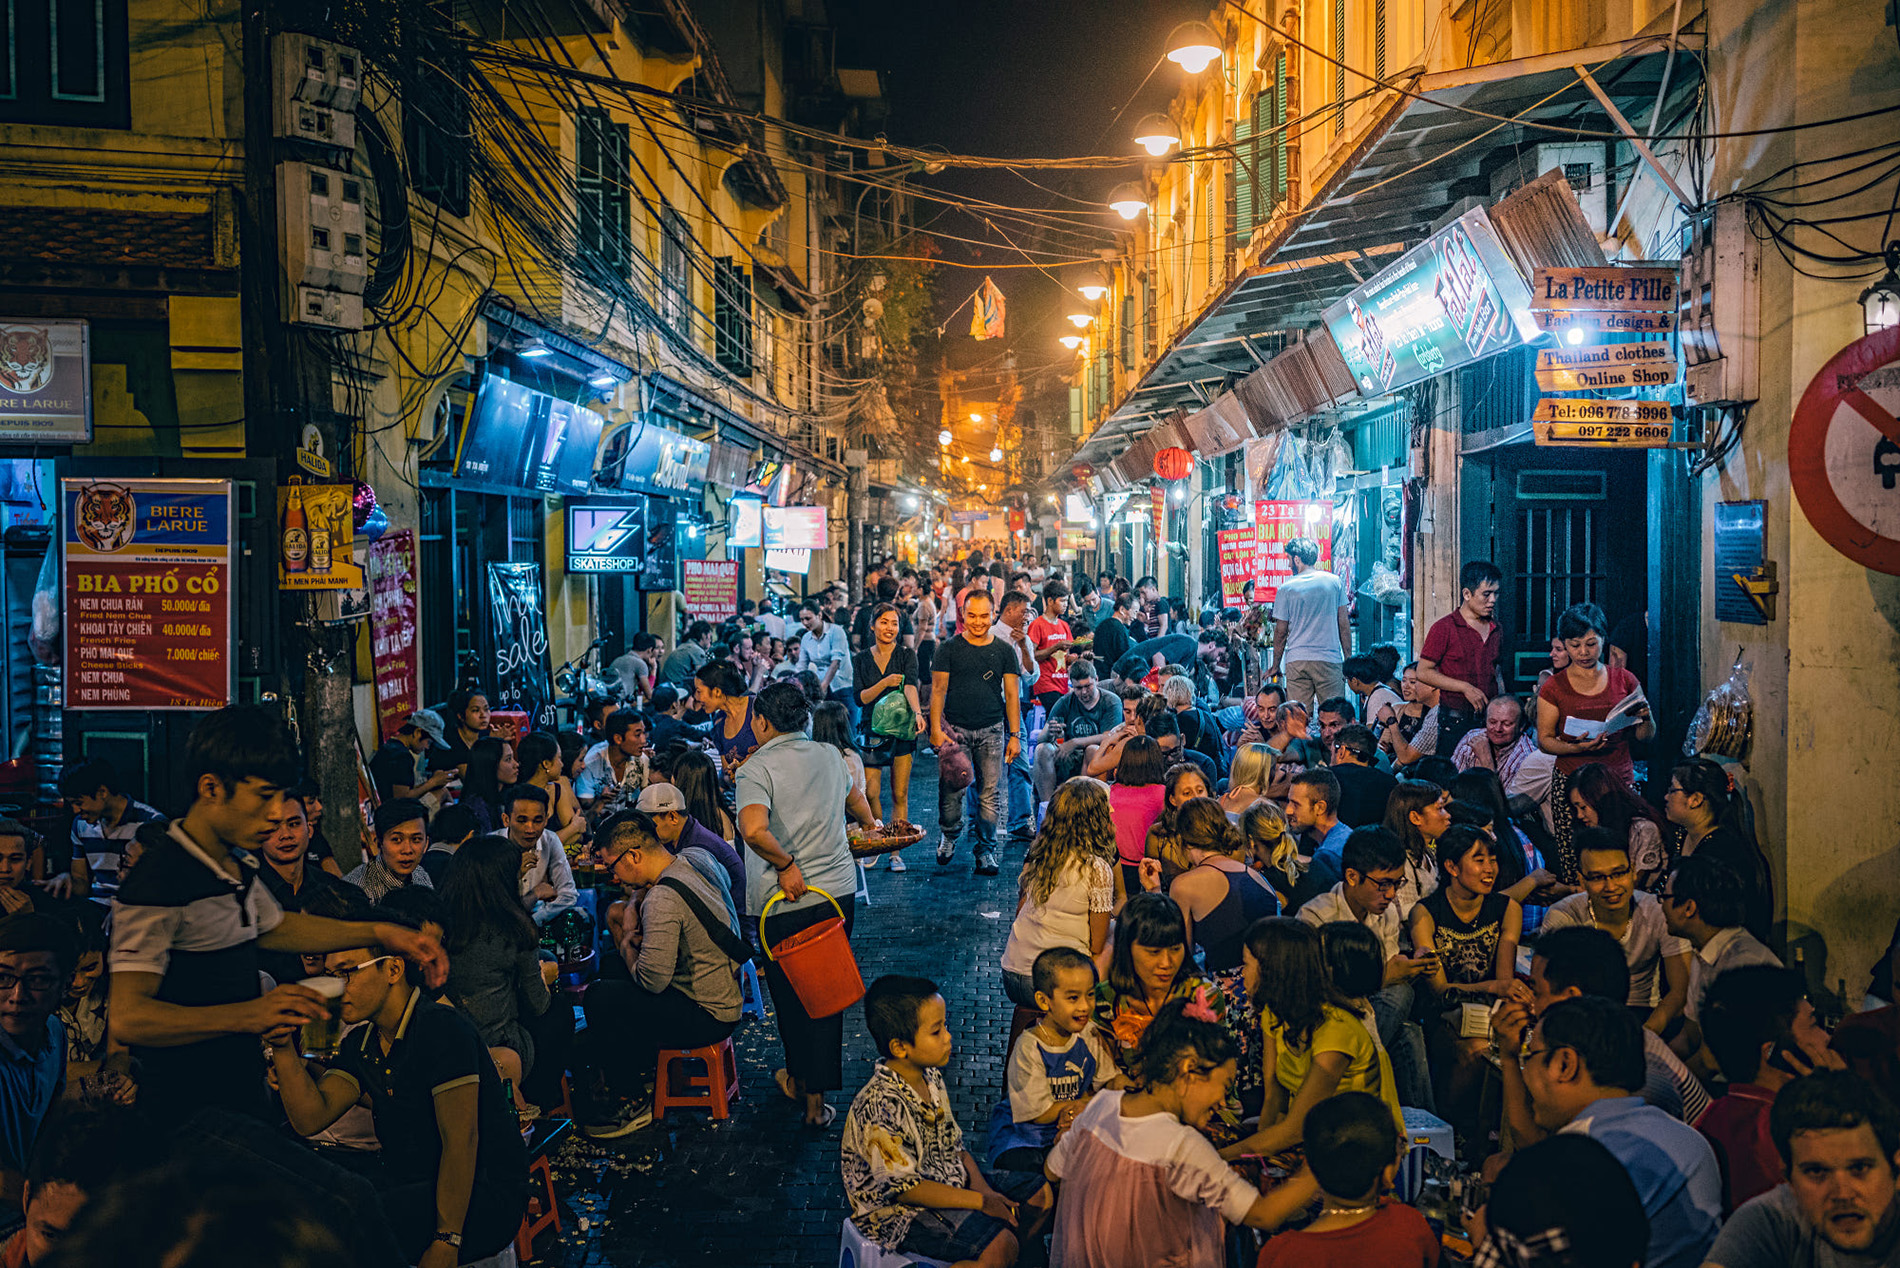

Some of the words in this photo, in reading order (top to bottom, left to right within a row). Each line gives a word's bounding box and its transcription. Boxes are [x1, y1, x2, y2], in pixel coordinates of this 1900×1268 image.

[1545, 276, 1568, 299] La
[1572, 277, 1625, 300] Petite
[1629, 278, 1672, 301] Fille
[1607, 314, 1653, 329] design
[1659, 315, 1670, 328] &
[1544, 348, 1610, 365] Thailand
[1615, 346, 1666, 360] clothes
[1577, 371, 1626, 387] Online
[1632, 369, 1669, 384] Shop
[22, 399, 72, 409] LARUE
[1549, 405, 1576, 418] Tel:
[1579, 406, 1603, 419] 096
[1606, 406, 1630, 419] 778
[1578, 426, 1602, 437] 097
[1606, 427, 1630, 437] 222
[1635, 427, 1669, 438] 6606
[301, 452, 328, 473] HALIDA
[151, 506, 204, 518] BIERE
[1261, 504, 1275, 516] 23
[146, 519, 208, 532] LARUE
[1258, 523, 1276, 539] BIA
[1224, 533, 1238, 541] PHO
[1240, 531, 1254, 539] MAI
[1221, 542, 1237, 551] NEM
[573, 558, 634, 569] SKATESHOP
[686, 561, 703, 575] PHO
[703, 562, 718, 575] MAI
[719, 562, 736, 578] QUE
[1235, 559, 1245, 576] GÀ
[77, 574, 122, 593] BIA
[129, 567, 179, 593] PHỐ
[186, 566, 219, 594] CỔ
[294, 577, 309, 585] MEN
[80, 598, 98, 611] NEM
[101, 598, 123, 611] CHUA
[700, 603, 720, 612] CHUA
[80, 611, 103, 619] Fried
[128, 612, 152, 620] Chua
[80, 622, 106, 635] KHOAI
[107, 620, 124, 635] TÂY
[80, 636, 111, 644] French
[114, 637, 137, 645] Fries
[497, 616, 548, 675] sale
[80, 647, 98, 659] PHO
[99, 647, 115, 659] MAI
[117, 647, 134, 661] QUE
[81, 661, 114, 669] Cheese
[116, 661, 144, 669] Sticks
[81, 671, 100, 684] NEM
[101, 671, 124, 684] CHUA
[81, 688, 100, 700] NEM
[511, 682, 521, 699] to
[539, 704, 557, 727] off
